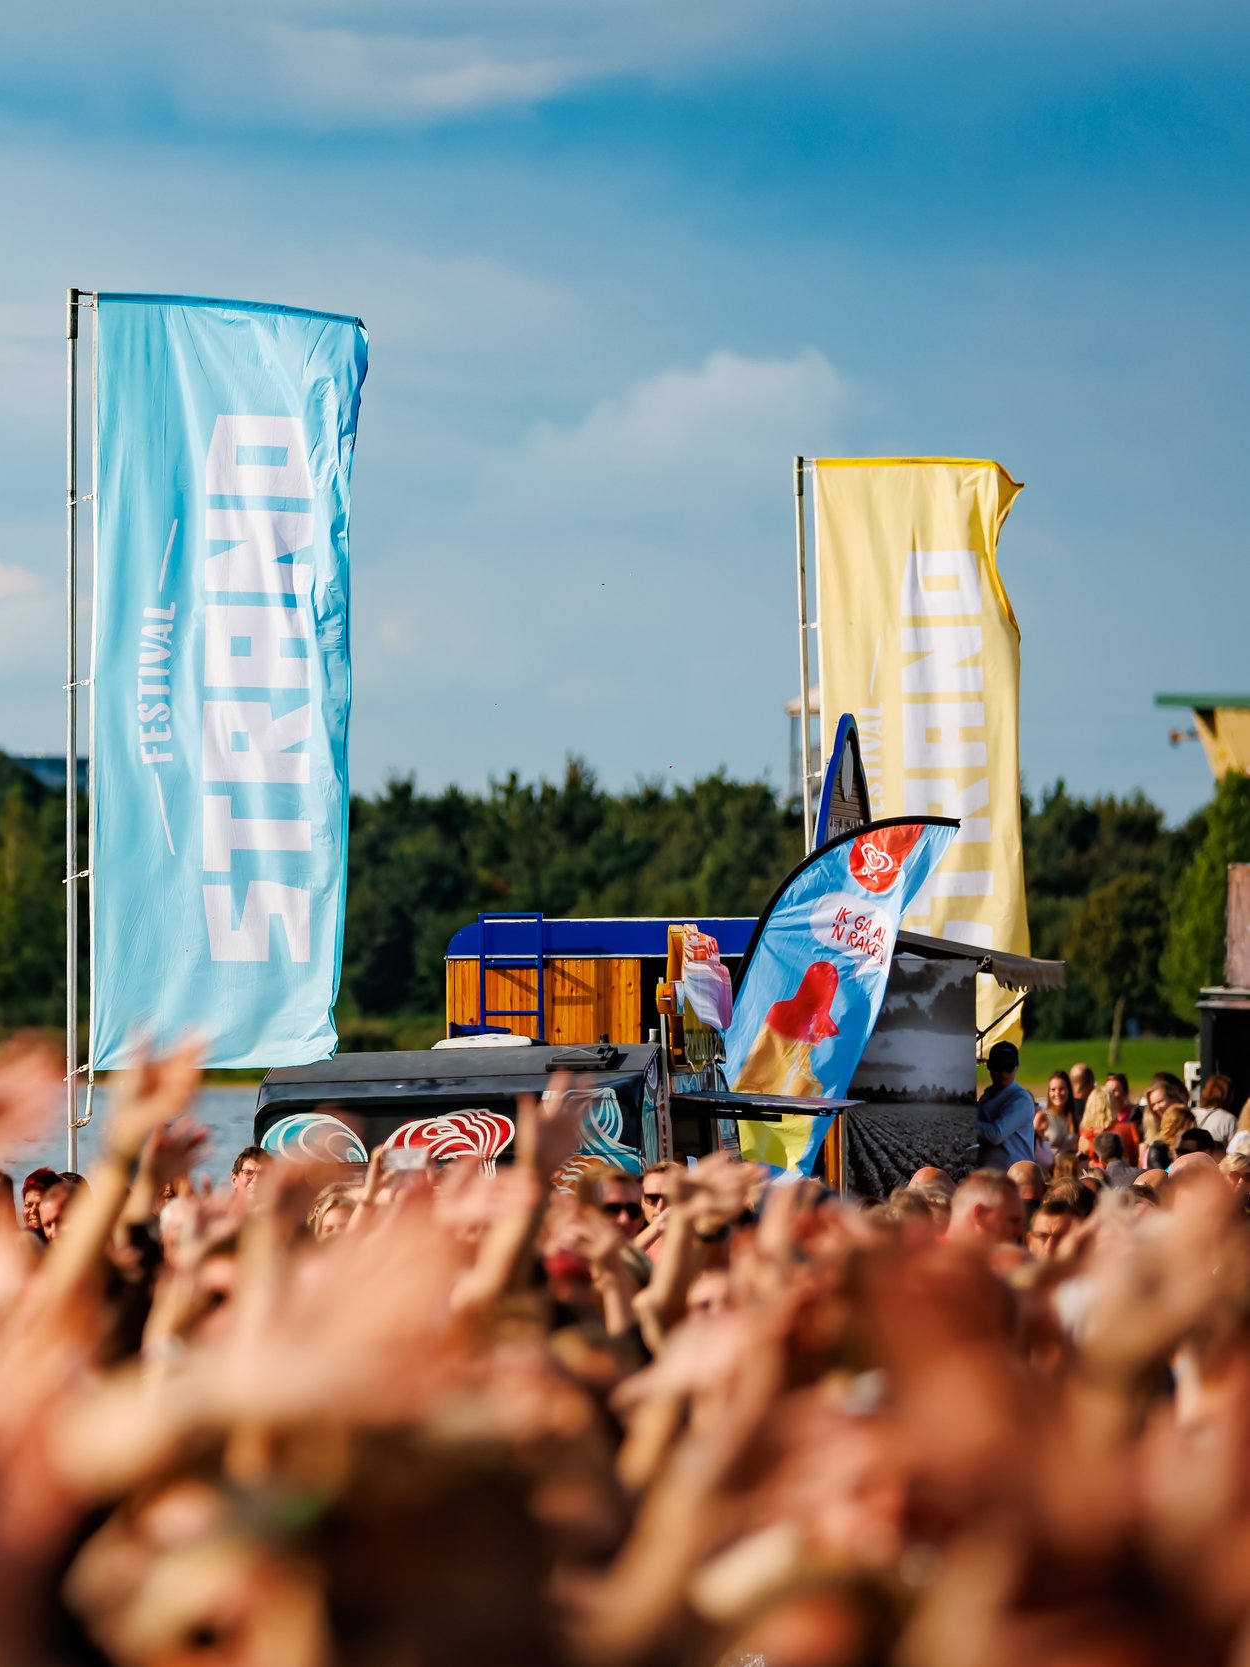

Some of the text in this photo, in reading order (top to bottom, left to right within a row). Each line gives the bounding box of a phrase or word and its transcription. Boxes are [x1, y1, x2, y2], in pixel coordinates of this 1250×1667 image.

[138, 600, 176, 765] FESTIVAL
[202, 414, 315, 963] STRAND
[835, 906, 852, 924] IK
[854, 915, 873, 935] GA
[861, 867, 879, 883] OLA
